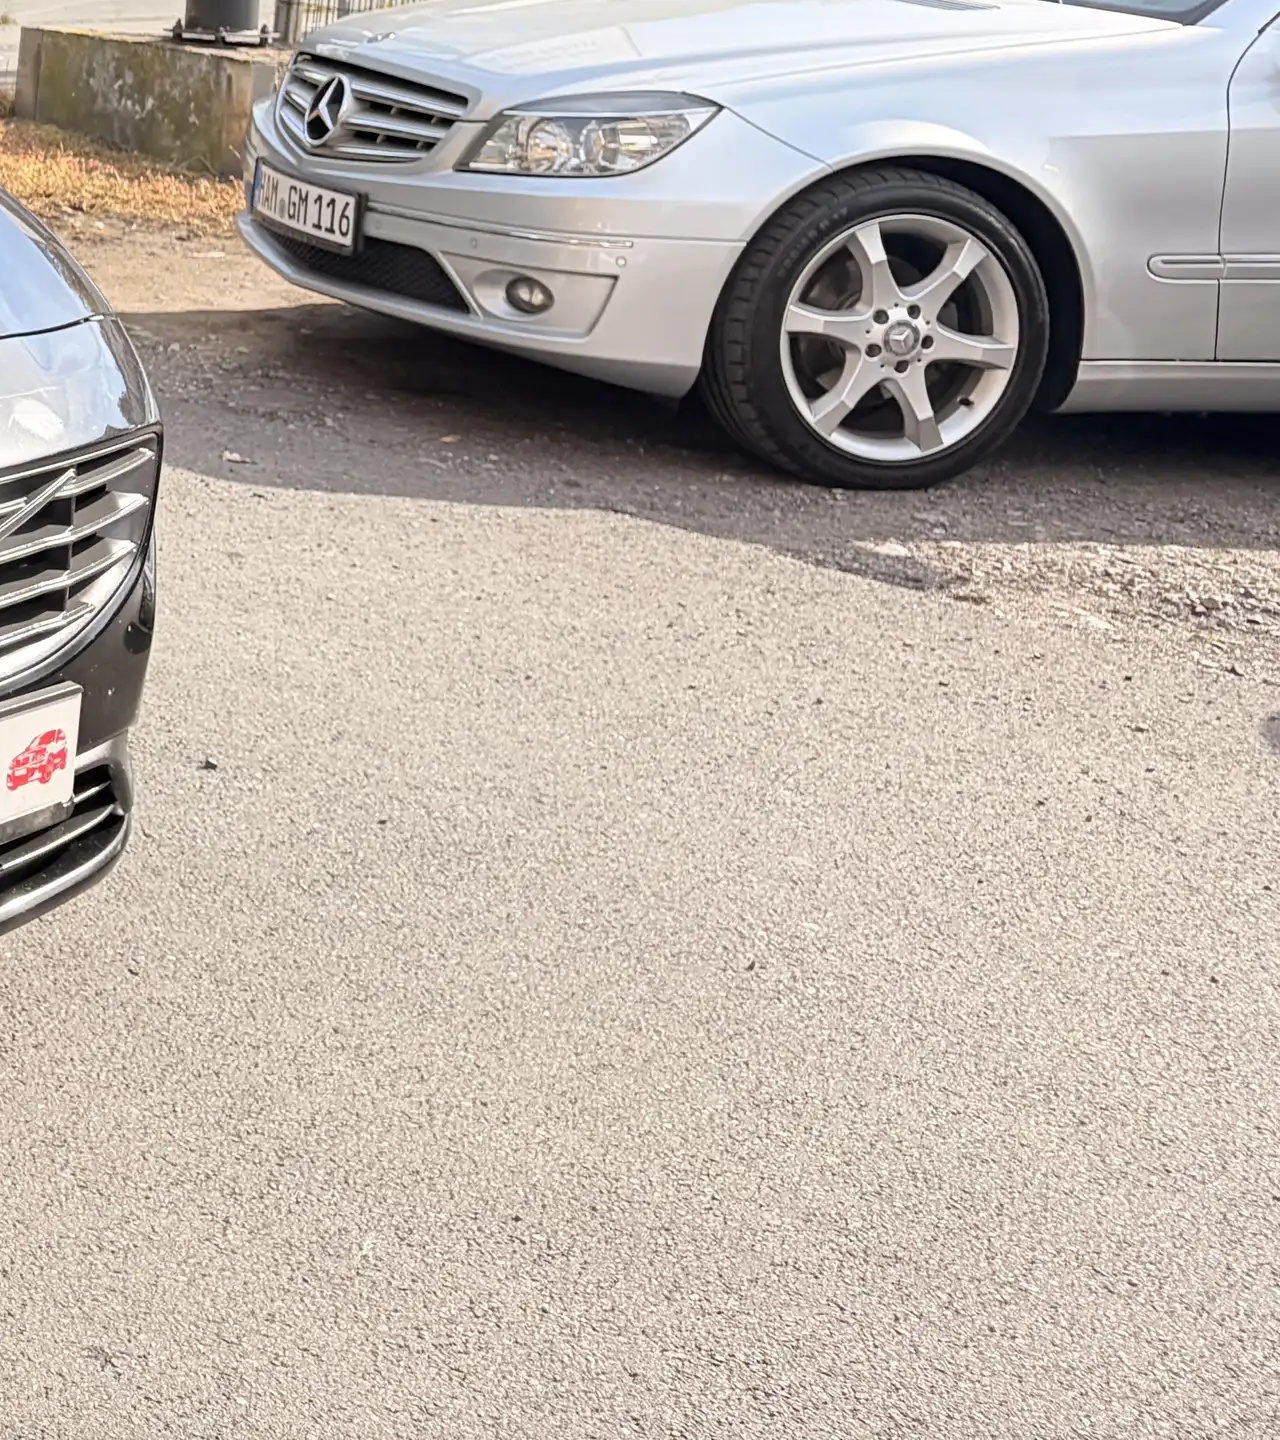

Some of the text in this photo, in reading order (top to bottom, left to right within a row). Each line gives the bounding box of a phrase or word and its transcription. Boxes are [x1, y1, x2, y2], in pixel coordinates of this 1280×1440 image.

[258, 171, 351, 238] HAM GM 116
